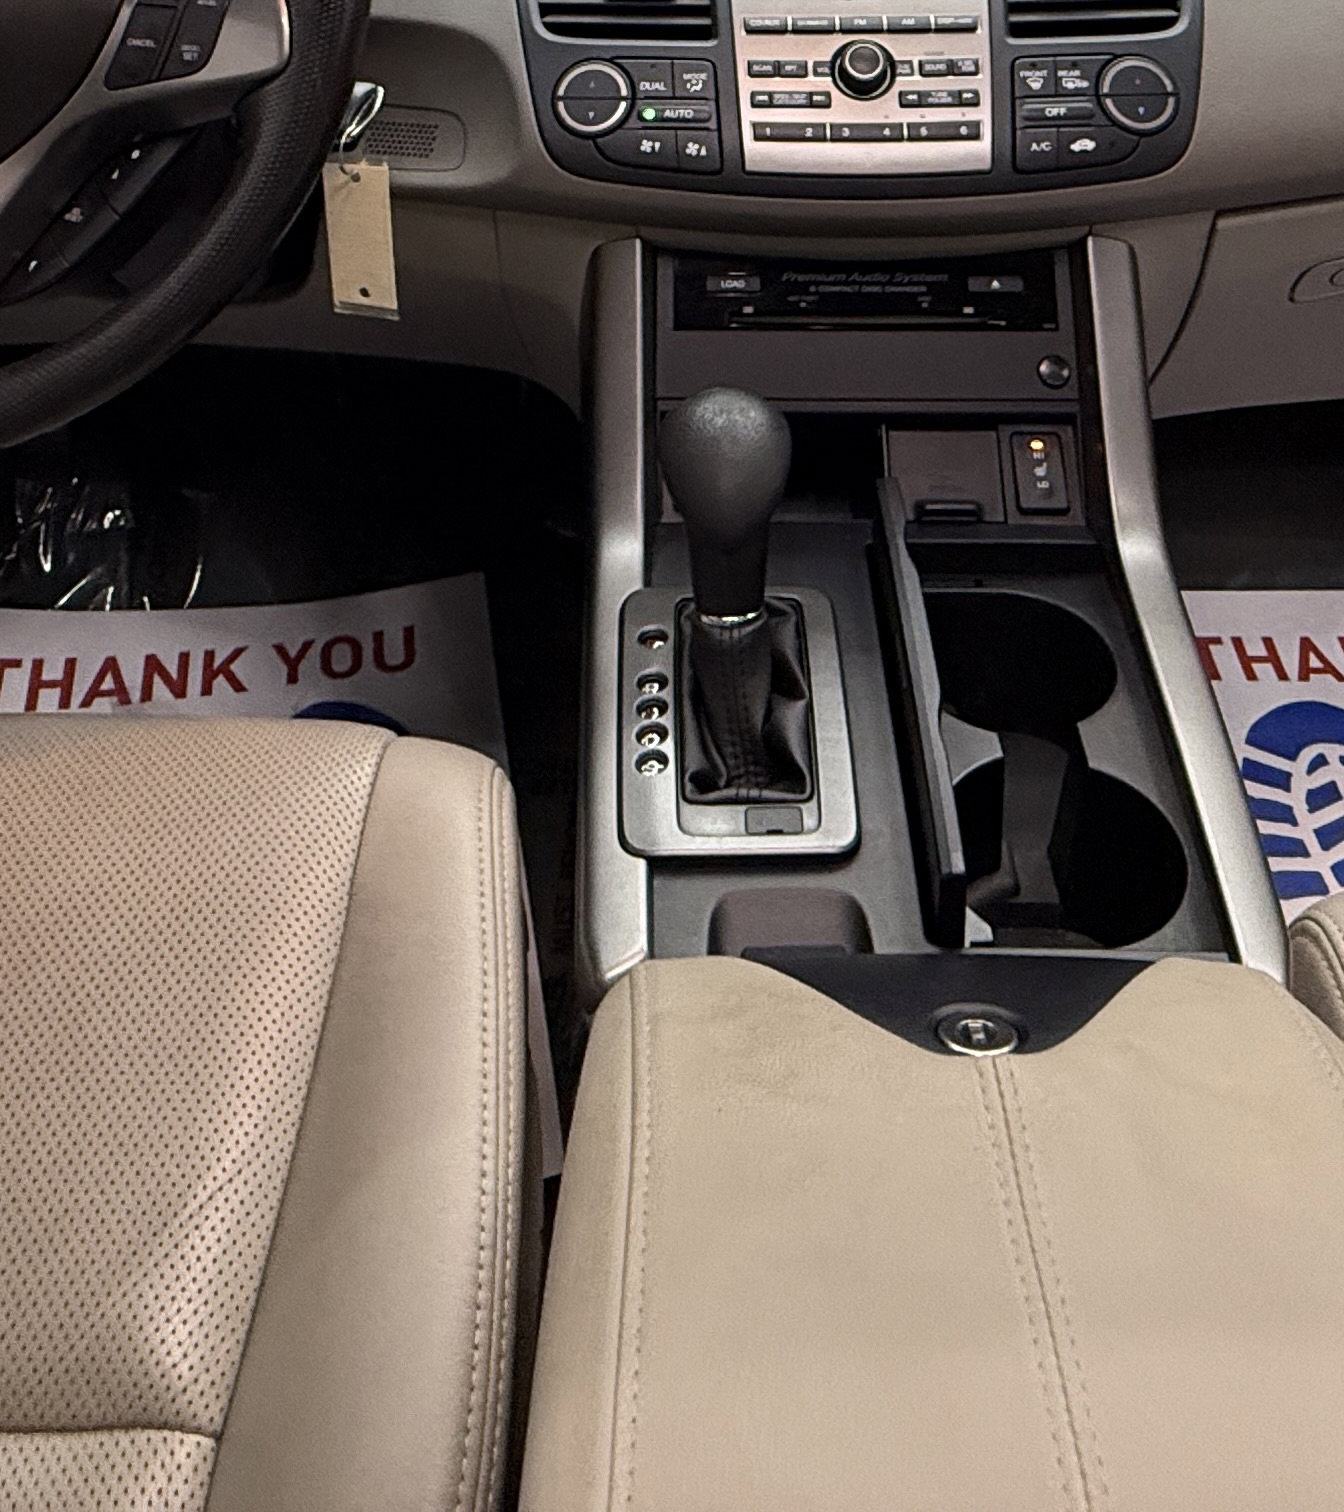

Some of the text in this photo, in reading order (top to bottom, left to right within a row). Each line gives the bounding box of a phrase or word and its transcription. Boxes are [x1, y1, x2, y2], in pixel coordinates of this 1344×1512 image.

[126, 37, 156, 48] CANCEL
[640, 81, 667, 91] DUAL
[663, 109, 693, 118] AUTO
[1044, 107, 1068, 117] OFF
[1030, 141, 1053, 152] A/C
[782, 272, 949, 283] Premium Audio System
[720, 279, 746, 289] LOAD
[272, 625, 416, 685] YOU
